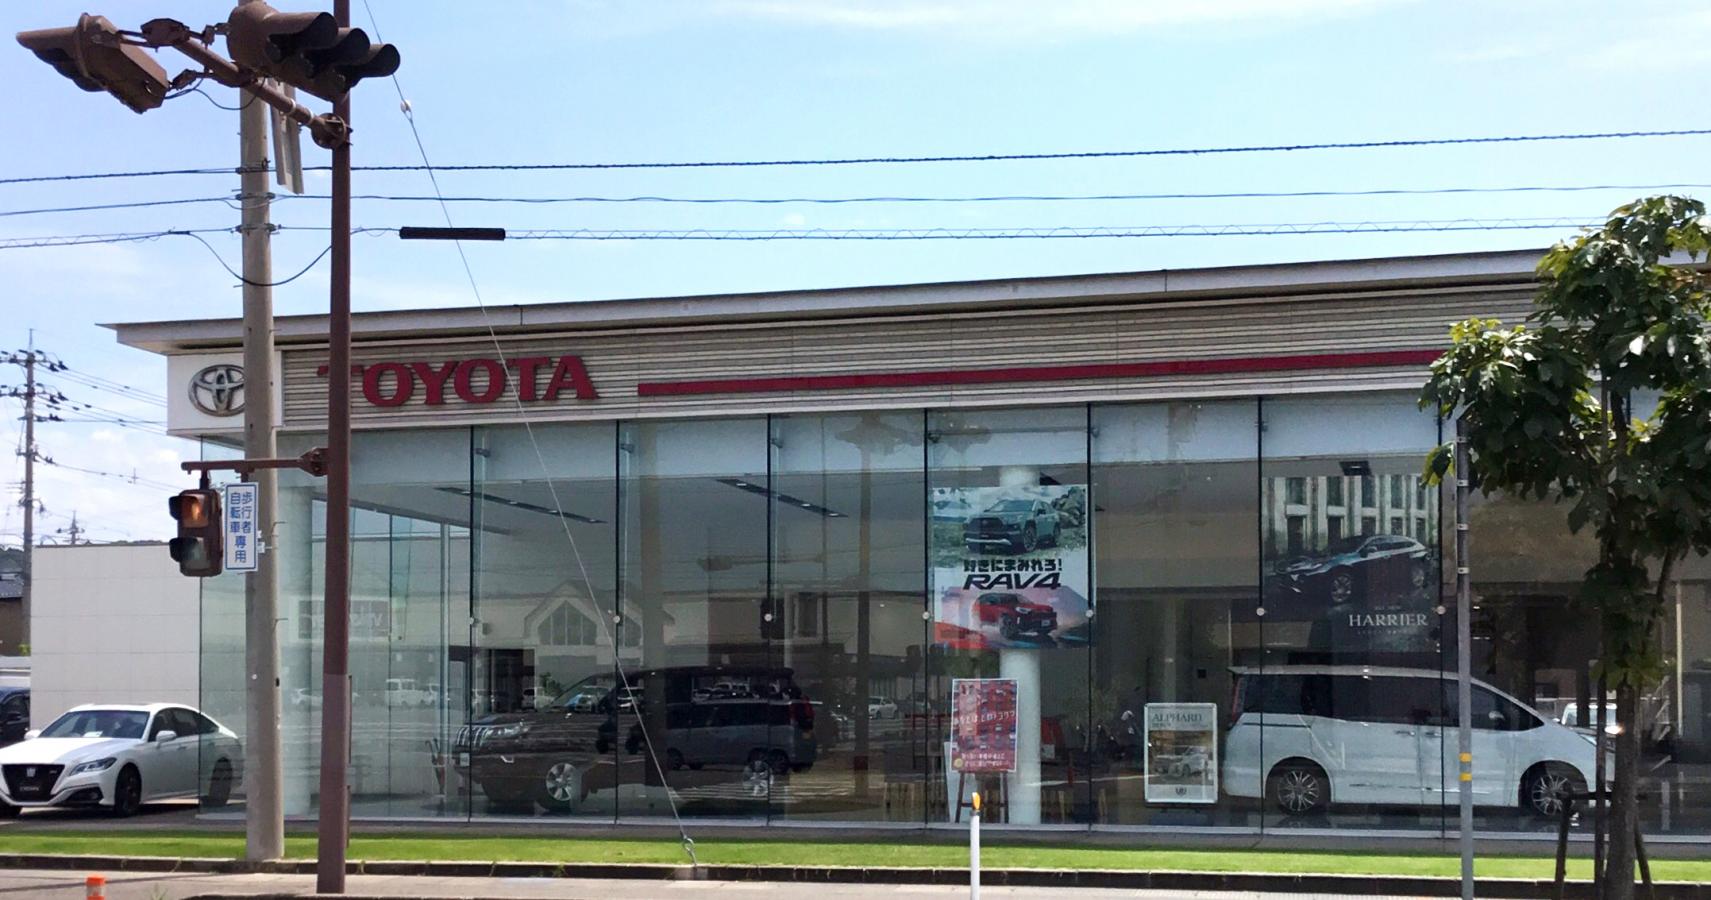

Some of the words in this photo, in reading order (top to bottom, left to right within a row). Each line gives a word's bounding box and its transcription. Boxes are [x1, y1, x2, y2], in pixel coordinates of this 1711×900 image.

[230, 492, 241, 533] 自転車
[241, 491, 253, 534] 歩行者
[234, 535, 247, 563] 専用
[962, 572, 1062, 590] RAV4
[1348, 613, 1428, 627] HARRIER
[1152, 712, 1203, 722] ALPHARD
